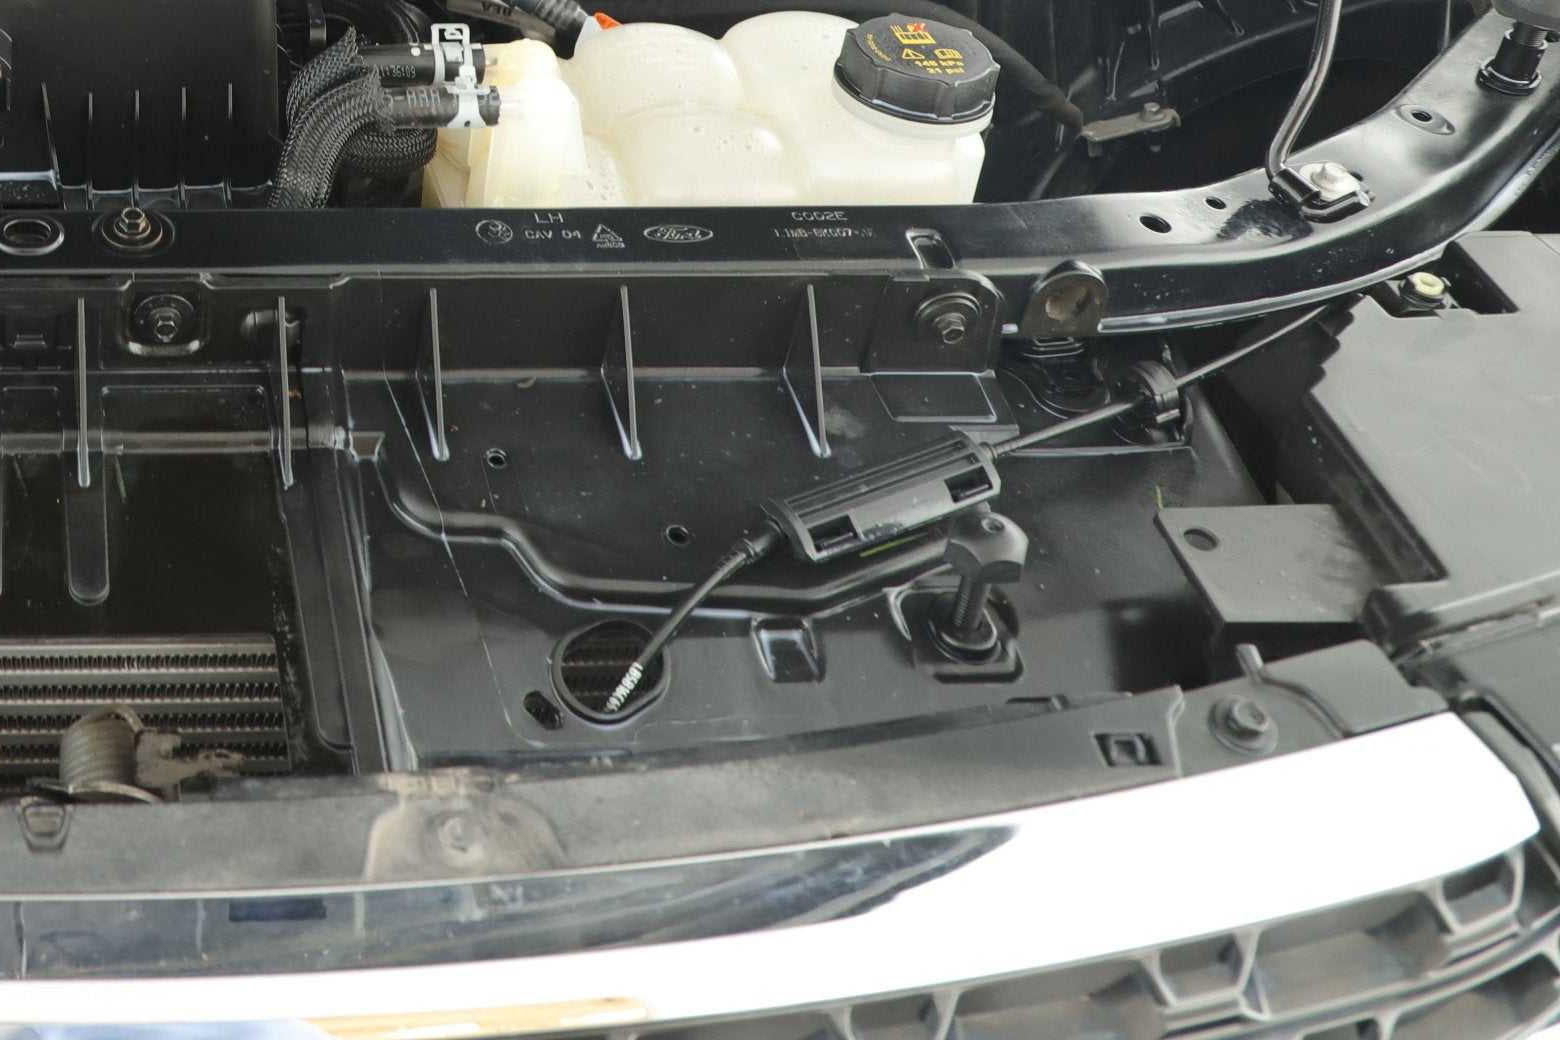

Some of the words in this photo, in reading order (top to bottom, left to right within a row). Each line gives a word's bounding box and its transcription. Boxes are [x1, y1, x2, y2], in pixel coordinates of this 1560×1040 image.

[534, 212, 564, 223] LH
[524, 230, 553, 239] CAV
[562, 230, 581, 239] 04
